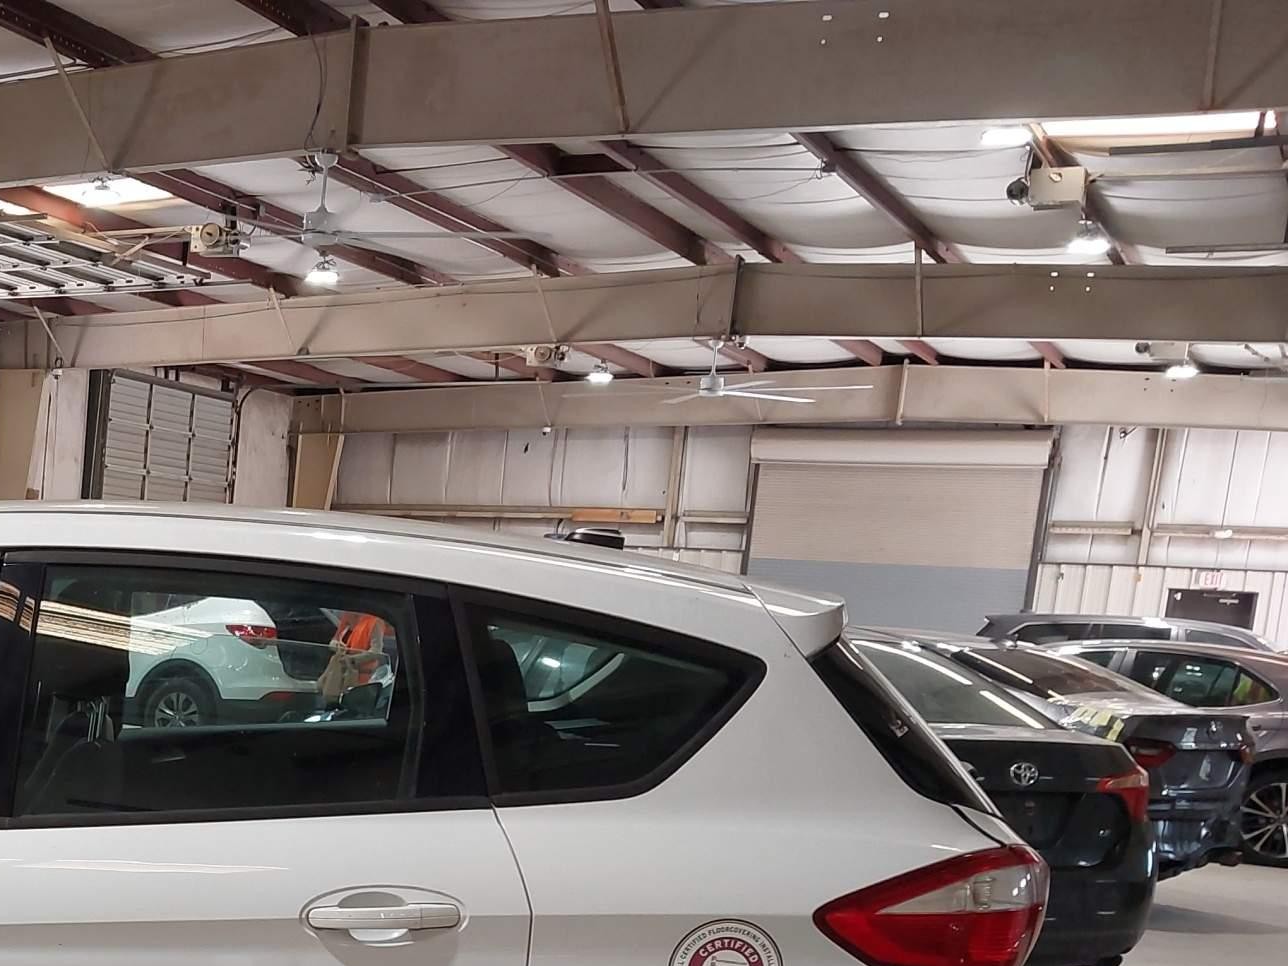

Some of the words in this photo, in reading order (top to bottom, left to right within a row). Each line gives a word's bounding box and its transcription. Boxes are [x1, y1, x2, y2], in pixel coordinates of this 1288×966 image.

[1204, 571, 1224, 585] EXIT
[679, 931, 708, 960] CERTIFIED
[708, 926, 761, 943] FLOORCOVERING
[698, 938, 759, 963] CERTIFIED
